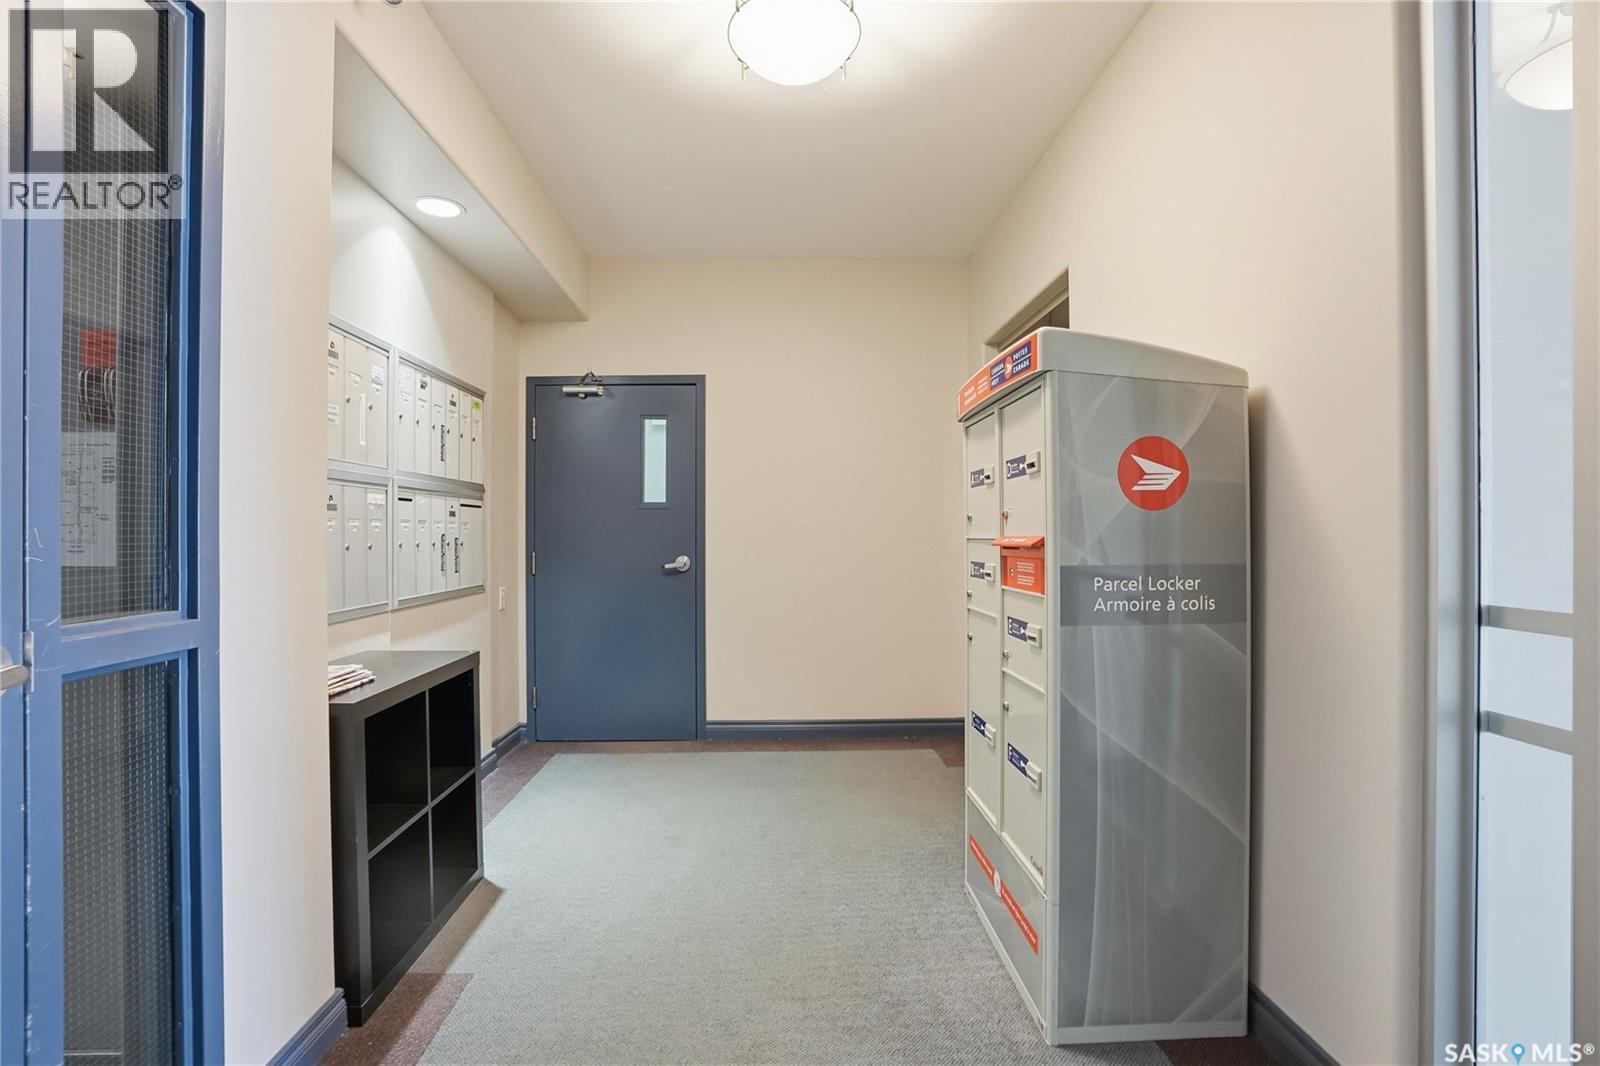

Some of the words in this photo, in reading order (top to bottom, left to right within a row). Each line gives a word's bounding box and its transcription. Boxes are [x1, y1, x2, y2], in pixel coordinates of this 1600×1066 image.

[1094, 576, 1142, 592] Parcel
[1148, 576, 1201, 591] Locker
[1093, 596, 1162, 612] Armoire
[1166, 596, 1176, 611] à
[1181, 595, 1216, 611] colis
